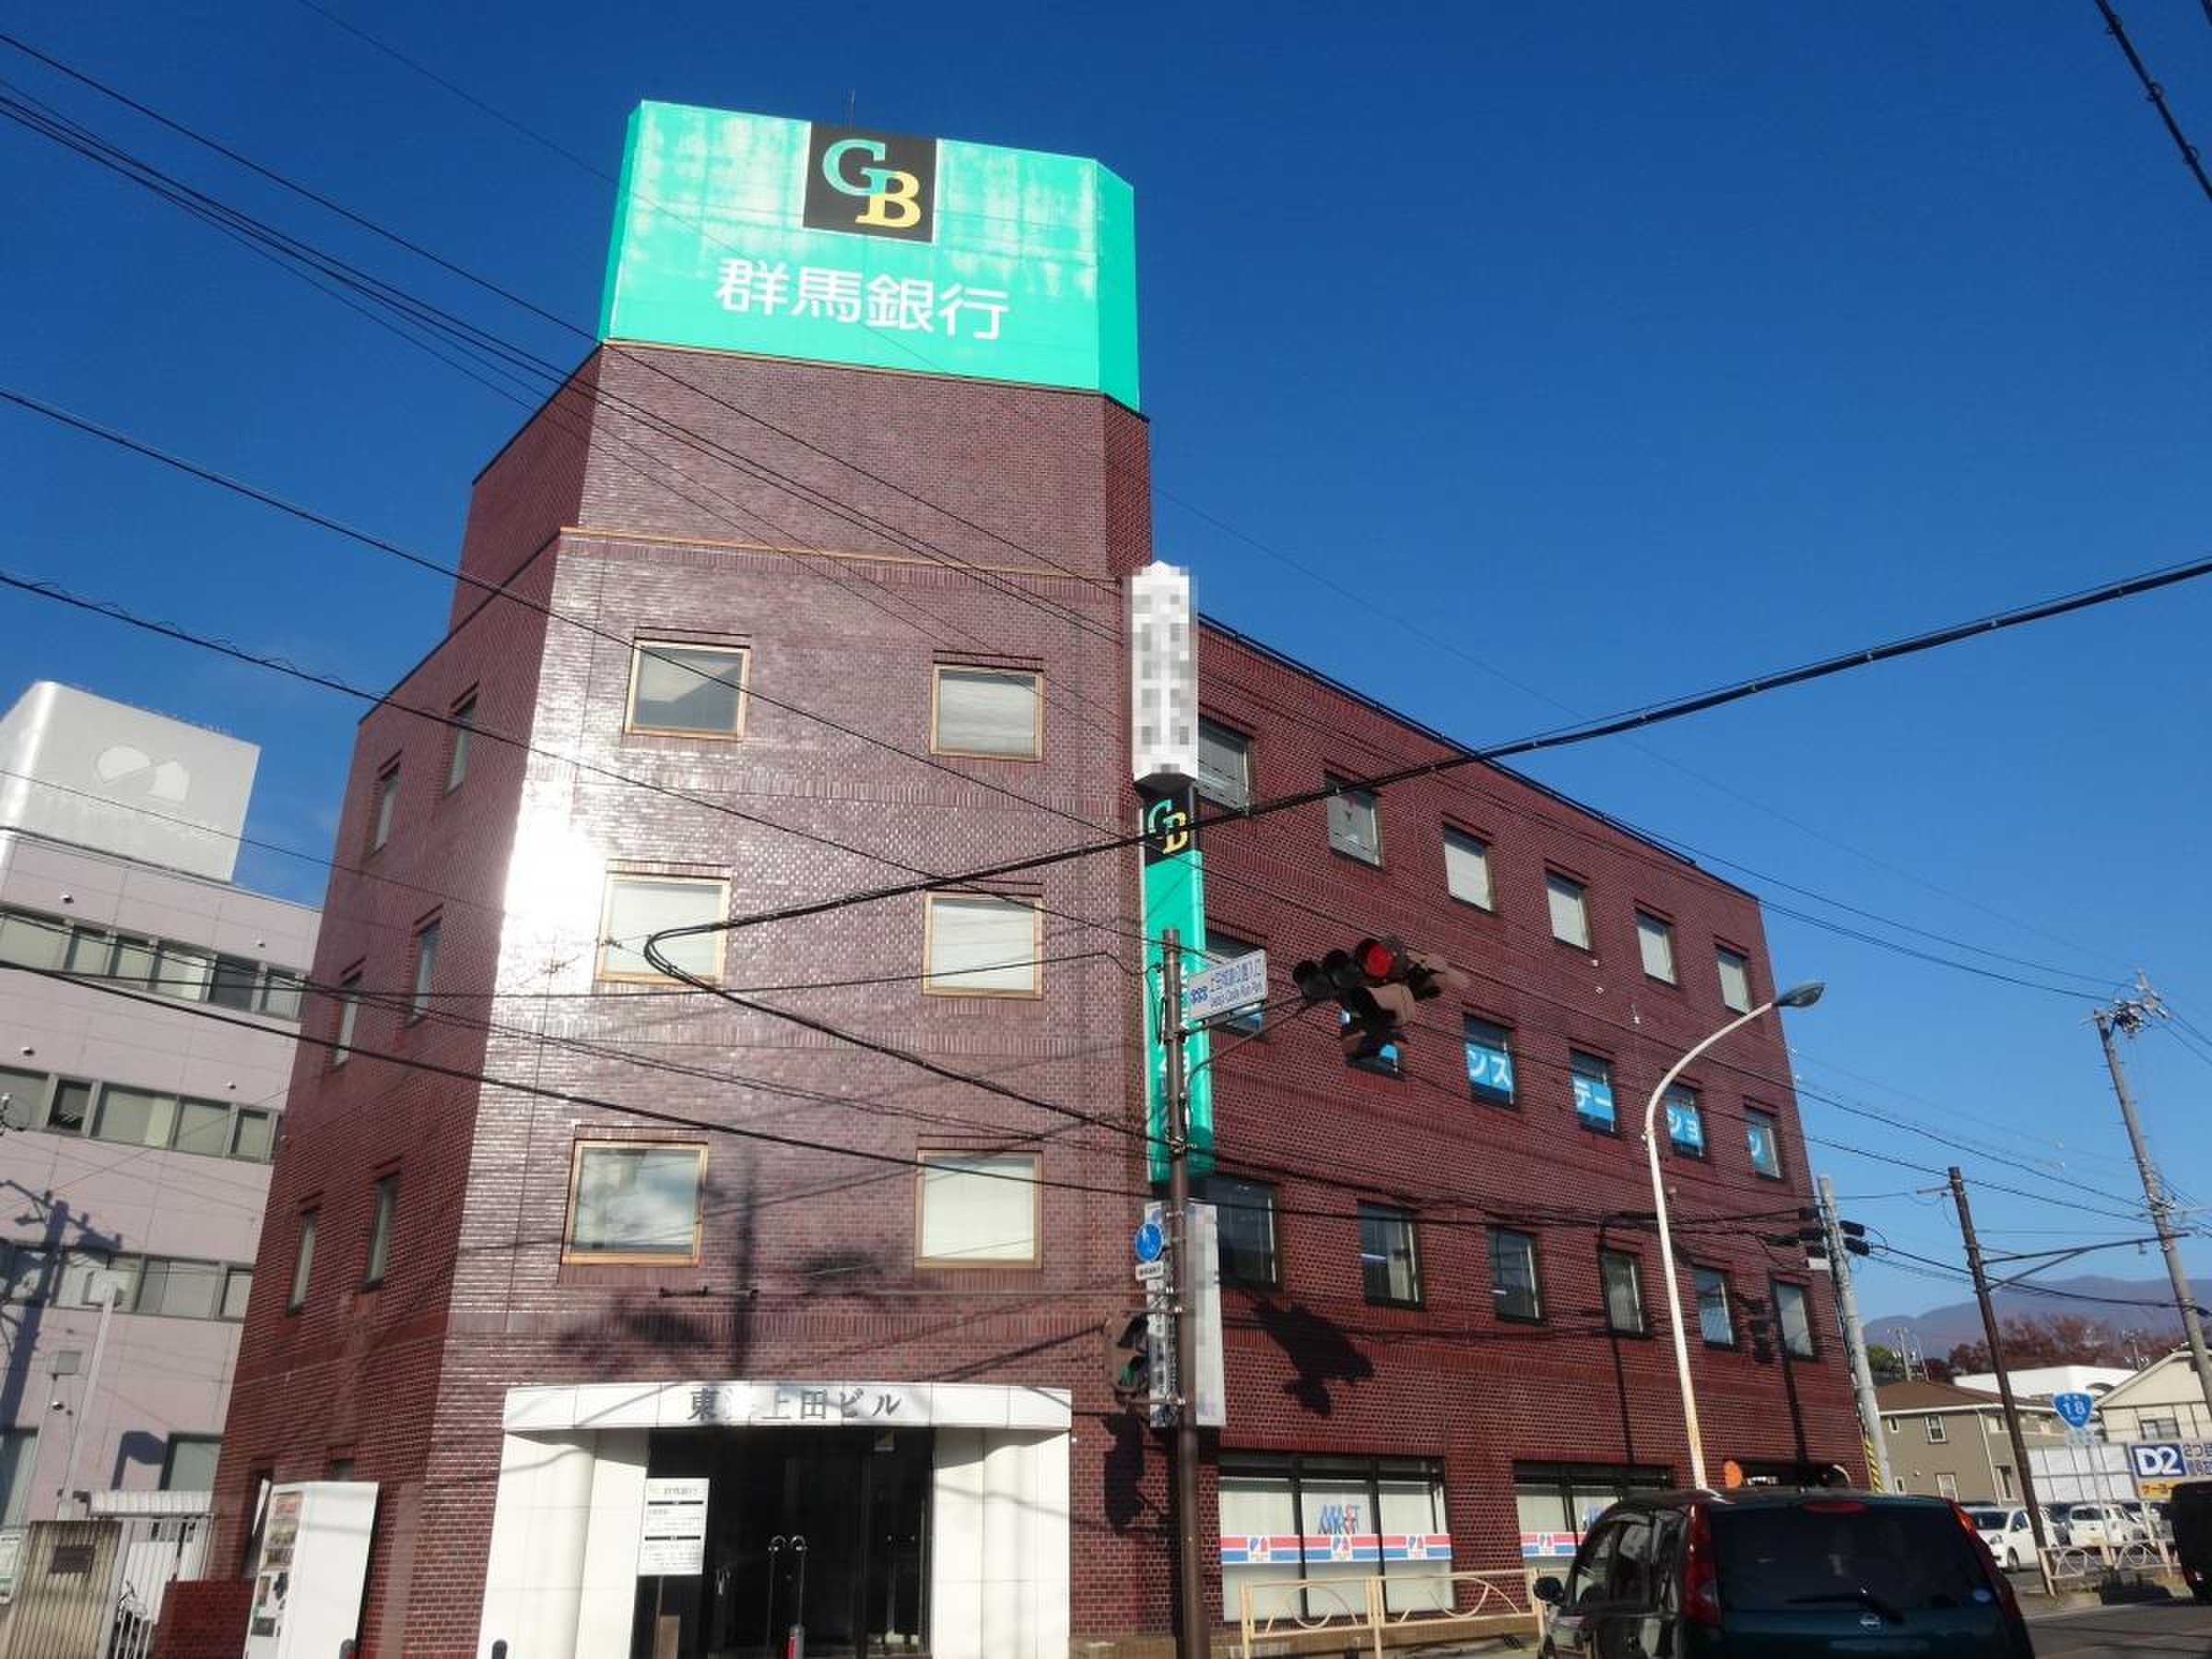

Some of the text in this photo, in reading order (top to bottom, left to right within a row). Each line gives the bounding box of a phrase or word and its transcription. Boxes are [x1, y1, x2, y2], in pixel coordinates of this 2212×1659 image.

[822, 138, 922, 229] GB
[714, 257, 1009, 340] 群馬銀行
[688, 1385, 901, 1420] 東上田ビル
[2062, 1400, 2087, 1416] 18
[2135, 1446, 2183, 1476] D2
